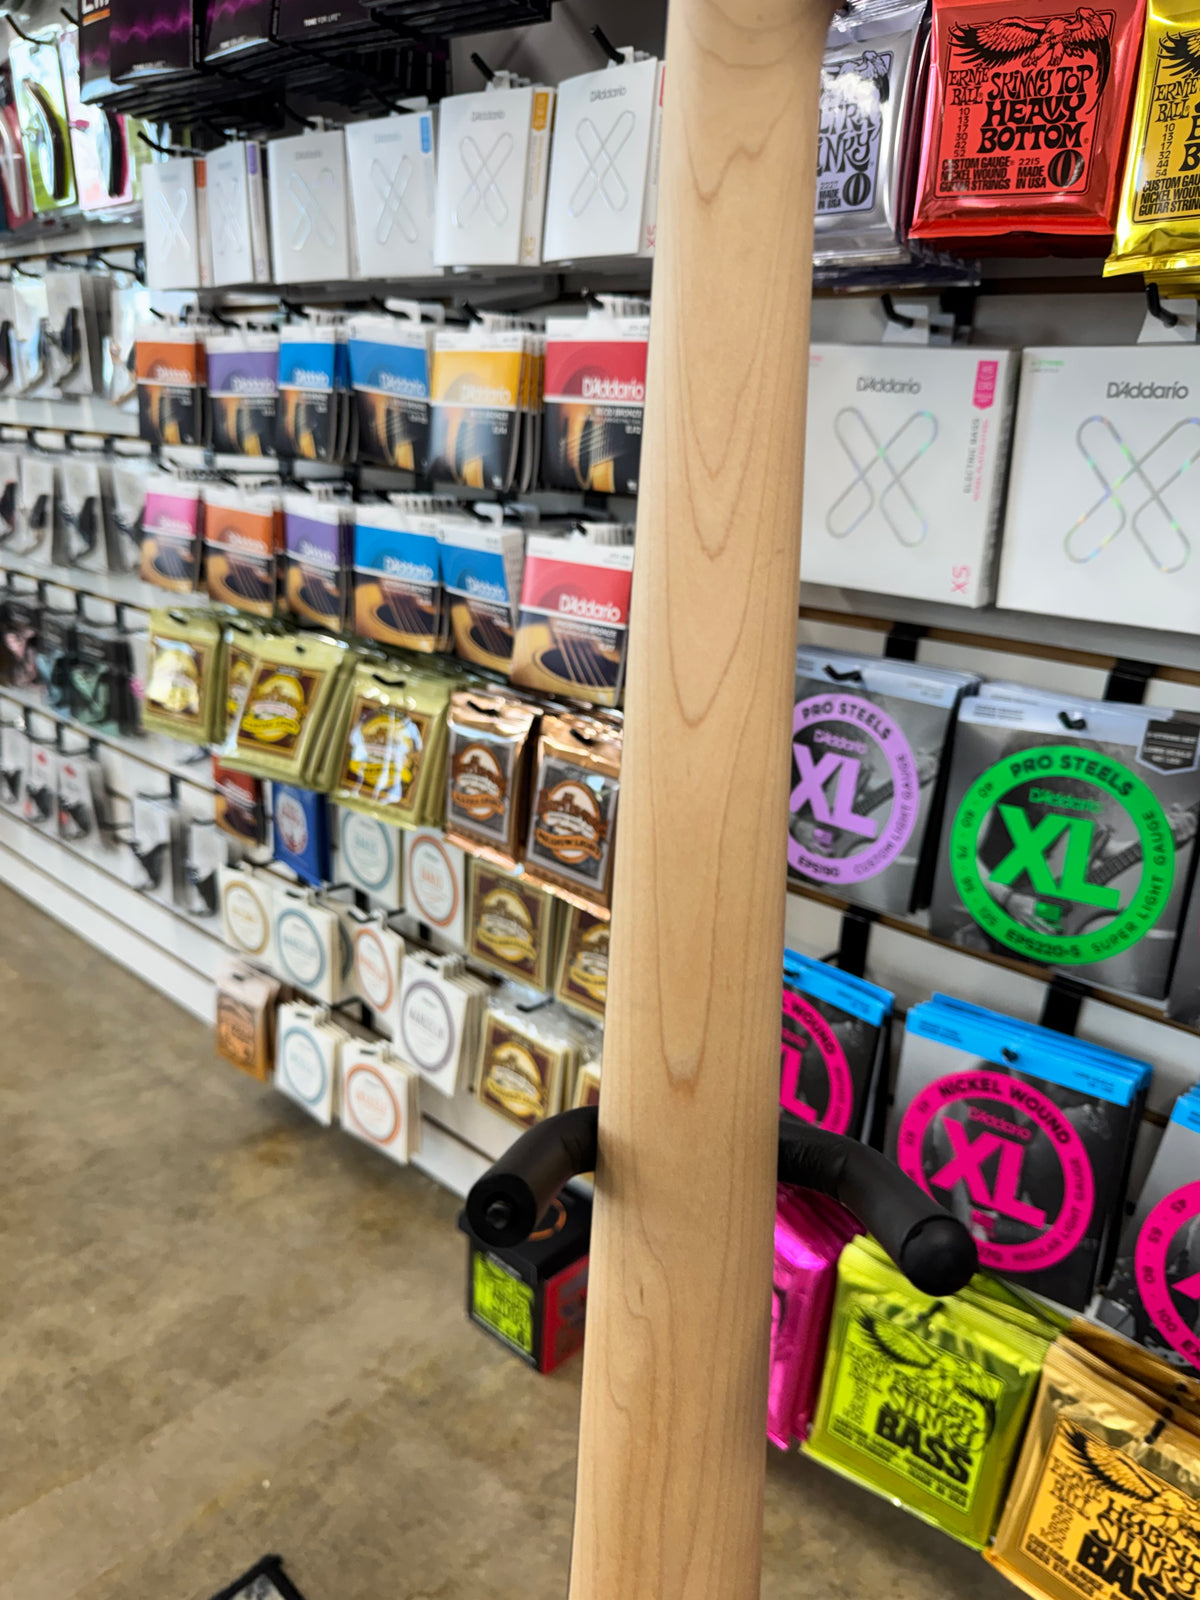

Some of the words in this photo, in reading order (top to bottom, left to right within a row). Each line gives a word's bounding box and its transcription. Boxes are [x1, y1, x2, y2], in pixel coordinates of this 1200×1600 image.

[948, 63, 990, 86] ERNIE
[987, 69, 1055, 100] SKINNY
[1056, 65, 1094, 94] TOP
[950, 86, 983, 106] BALL
[1154, 76, 1199, 101] ERNIE
[959, 107, 970, 115] 10
[982, 93, 1087, 127] HEAVY
[1155, 100, 1188, 122] BALL
[819, 103, 876, 136] LTRA
[958, 116, 969, 124] 13
[1164, 123, 1175, 132] 10
[957, 124, 968, 132] 17
[954, 141, 966, 149] 42
[955, 133, 968, 141] 30
[976, 121, 1088, 154] BOTTOM
[1163, 133, 1174, 141] 13
[953, 149, 965, 157] 52
[1161, 142, 1172, 151] 17
[942, 158, 980, 170] CUSTOM
[980, 156, 1011, 168] GAUGE
[1018, 158, 1040, 166] 2215
[1158, 151, 1171, 160] 32
[1017, 166, 1044, 177] MADE
[1156, 161, 1169, 169] 44
[973, 167, 1007, 180] WOUND
[1155, 169, 1167, 178] 54
[971, 179, 1010, 191] STRINGS
[1016, 178, 1027, 189] IN
[1027, 177, 1047, 188] USA
[1142, 177, 1181, 193] CUSTOM
[819, 189, 839, 199] MADE
[1140, 190, 1171, 205] NICKEL
[827, 199, 841, 209] USA
[1138, 201, 1169, 217] GUITAR
[1106, 382, 1188, 400] D'Addario
[951, 565, 970, 594] XS
[801, 701, 833, 719] PRO
[838, 702, 892, 741] STEELS
[1009, 754, 1054, 778] PRO
[1060, 753, 1135, 798] STEELS
[789, 742, 877, 838] XL
[1141, 809, 1168, 867] GAUGE
[988, 802, 1121, 911] XL
[1135, 874, 1166, 921] LIGHT
[1090, 920, 1139, 954] SUPER
[938, 1077, 1002, 1096] NICKEL
[1009, 1085, 1071, 1145] WOUND
[929, 1115, 1047, 1229] XL
[1156, 1307, 1178, 1334] 100
[874, 1402, 973, 1485] BASS
